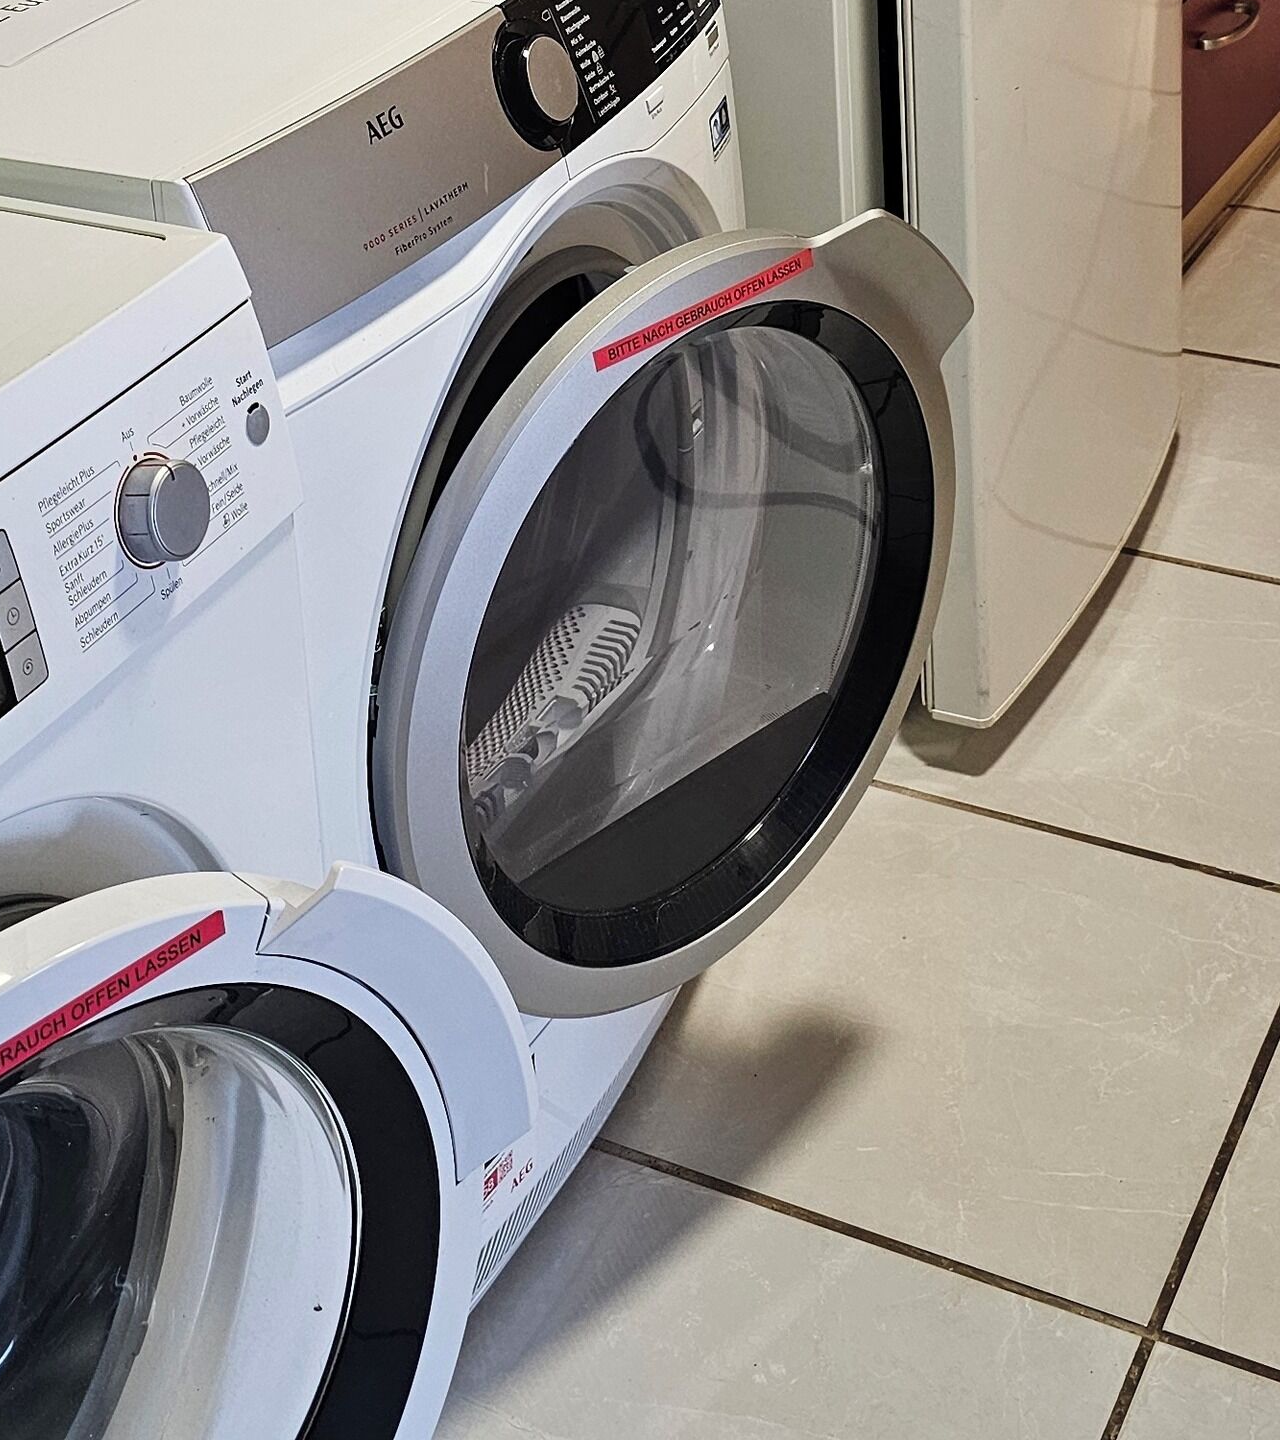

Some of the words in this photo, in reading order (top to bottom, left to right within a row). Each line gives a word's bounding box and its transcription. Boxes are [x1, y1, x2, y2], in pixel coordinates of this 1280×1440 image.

[365, 105, 404, 144] AEG
[363, 233, 386, 252] 9000
[388, 215, 417, 238] SERIES
[424, 182, 469, 215] LAVATHERM
[394, 232, 427, 256] FiberPro
[428, 215, 453, 237] System
[608, 338, 640, 361] BITTE
[643, 322, 673, 345] NACH
[675, 295, 732, 329] GEBRAUCH
[734, 277, 765, 301] OFFEN
[767, 257, 802, 284] LASSEN
[179, 376, 213, 407] Baumwolle
[231, 378, 264, 408] Nachlegen
[235, 370, 252, 388] Start
[185, 396, 219, 426] Vorwäsche
[120, 427, 135, 443] Aus
[189, 415, 225, 448] Pflegeleicht
[197, 436, 231, 467] Vorwäsche
[37, 474, 79, 513] Pflegeleicht
[78, 465, 95, 481] Plus
[208, 463, 239, 493] chnell/Mix
[211, 482, 244, 513] Fein/Seide
[231, 501, 249, 521] Wolle
[45, 497, 86, 534] Sportswear
[52, 519, 94, 556] AllergiePlus
[58, 554, 79, 577] Extra
[77, 543, 94, 563] Kurz
[64, 573, 85, 594] Sanft
[69, 570, 108, 607] Schleudern
[160, 576, 183, 600] Spülen
[74, 593, 112, 627] Abpumpen
[80, 611, 119, 649] Schleudern
[70, 976, 131, 1019] OFFEN
[134, 928, 202, 982] LASSEN
[511, 1157, 533, 1193] AEG
